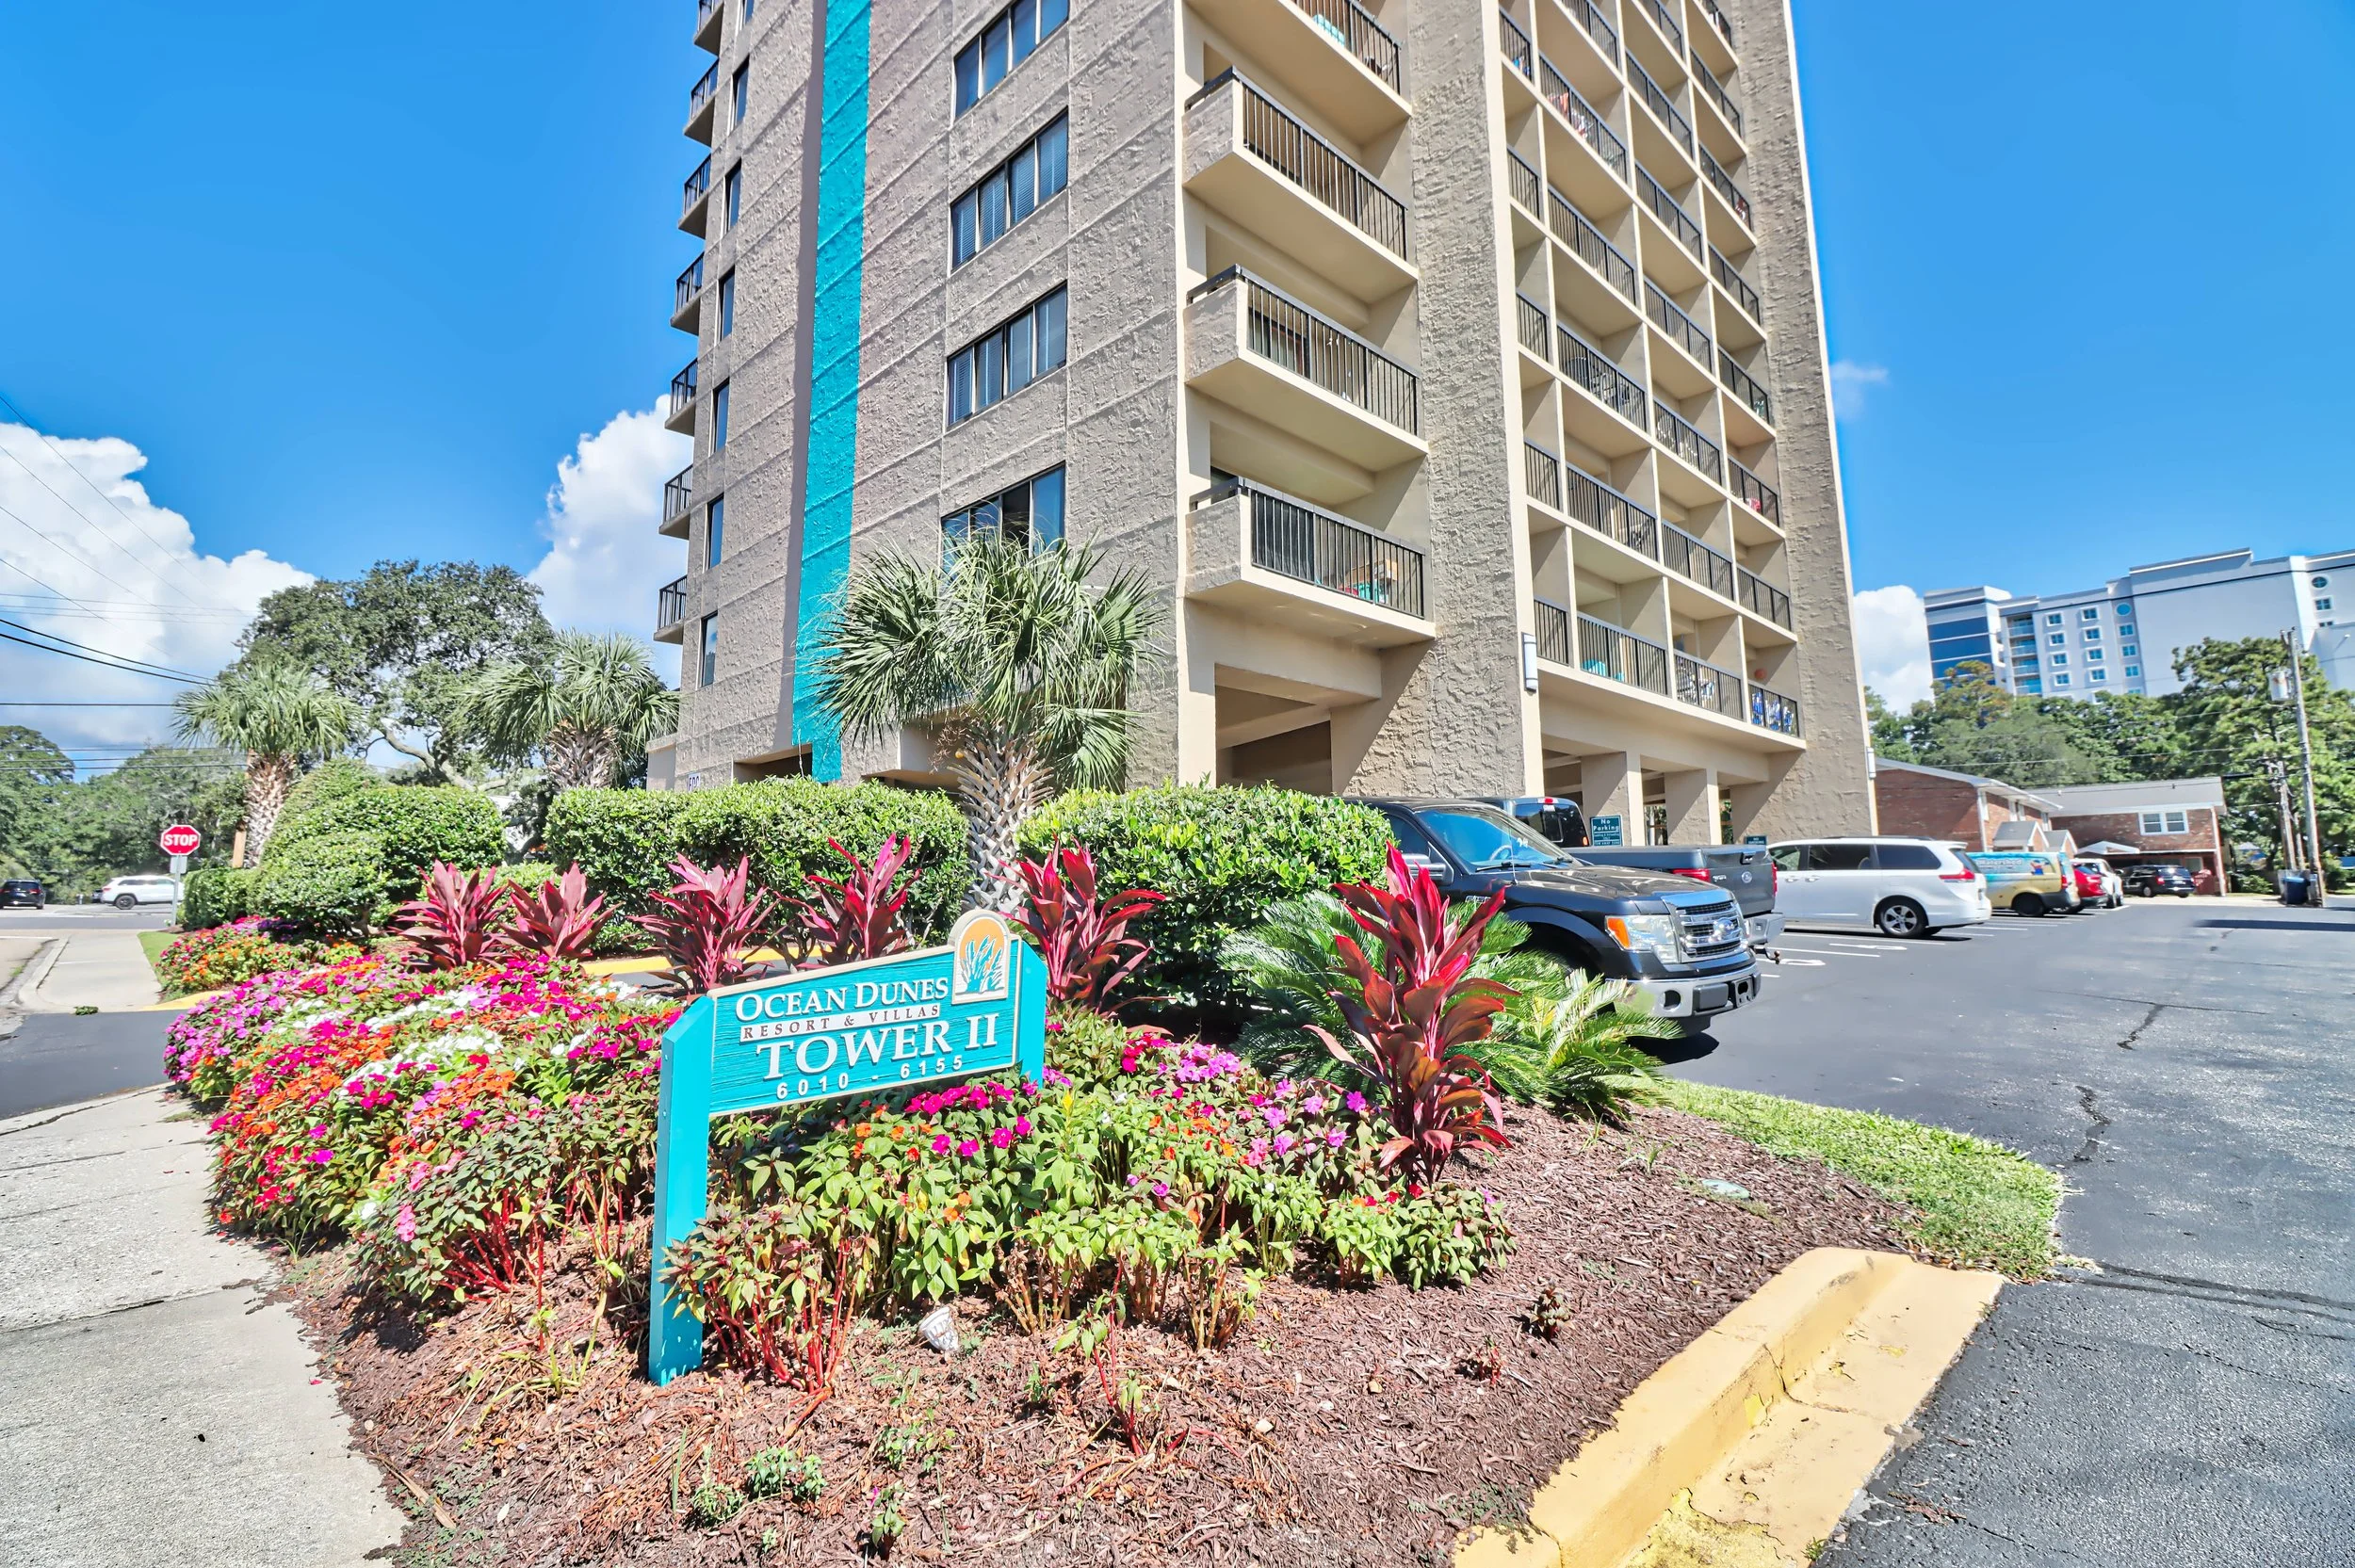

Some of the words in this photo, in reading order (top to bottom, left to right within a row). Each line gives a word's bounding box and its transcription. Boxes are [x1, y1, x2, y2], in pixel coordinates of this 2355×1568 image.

[164, 833, 198, 847] STOP
[1593, 824, 1619, 832] Parking
[735, 987, 847, 1022] OCEAN
[854, 977, 949, 1009] DUNES
[743, 1017, 830, 1040] RESORT
[843, 1015, 854, 1027] &
[869, 1005, 939, 1024] VILLAS
[755, 1020, 953, 1080] TOWER
[965, 1012, 999, 1049] II
[776, 1073, 850, 1100] 6010
[900, 1055, 963, 1079] 6155
